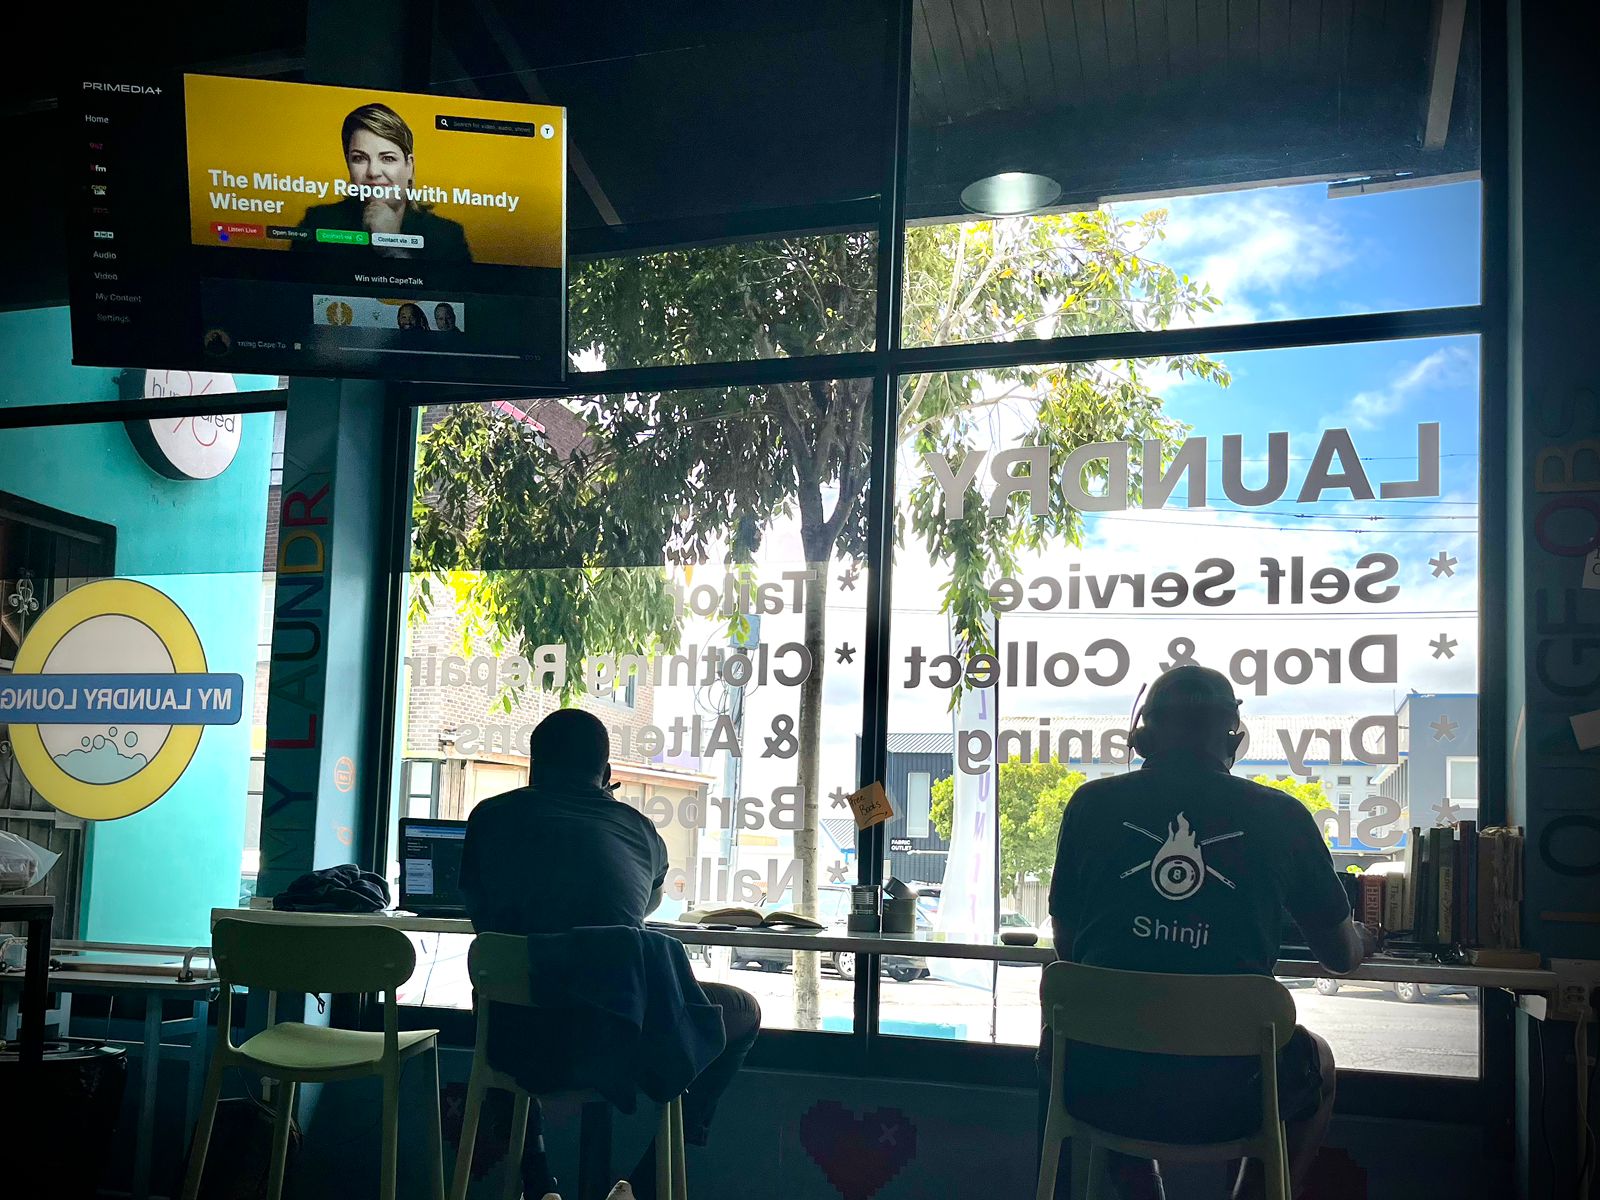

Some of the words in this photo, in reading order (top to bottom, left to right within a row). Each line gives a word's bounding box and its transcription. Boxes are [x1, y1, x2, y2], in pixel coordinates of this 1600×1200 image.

[82, 81, 163, 96] PRIMEDIA+
[84, 113, 110, 124] Home
[208, 169, 249, 188] The
[252, 172, 330, 199] Midday
[334, 179, 401, 202] Report
[405, 184, 448, 203] with
[452, 187, 520, 212] Mandy
[209, 192, 285, 214] Wiener
[272, 228, 288, 236] Open
[377, 236, 399, 244] Contact
[93, 250, 117, 260] Audio
[94, 271, 118, 281] Video
[354, 274, 370, 282] Win
[371, 275, 388, 284] with
[389, 276, 424, 287] CapeTalk
[95, 292, 109, 303] My
[110, 293, 142, 303] Content
[97, 313, 131, 325] Settings
[266, 453, 331, 750] LAUNDRY
[1172, 868, 1182, 880] 8
[1131, 915, 1210, 949] Shinji
